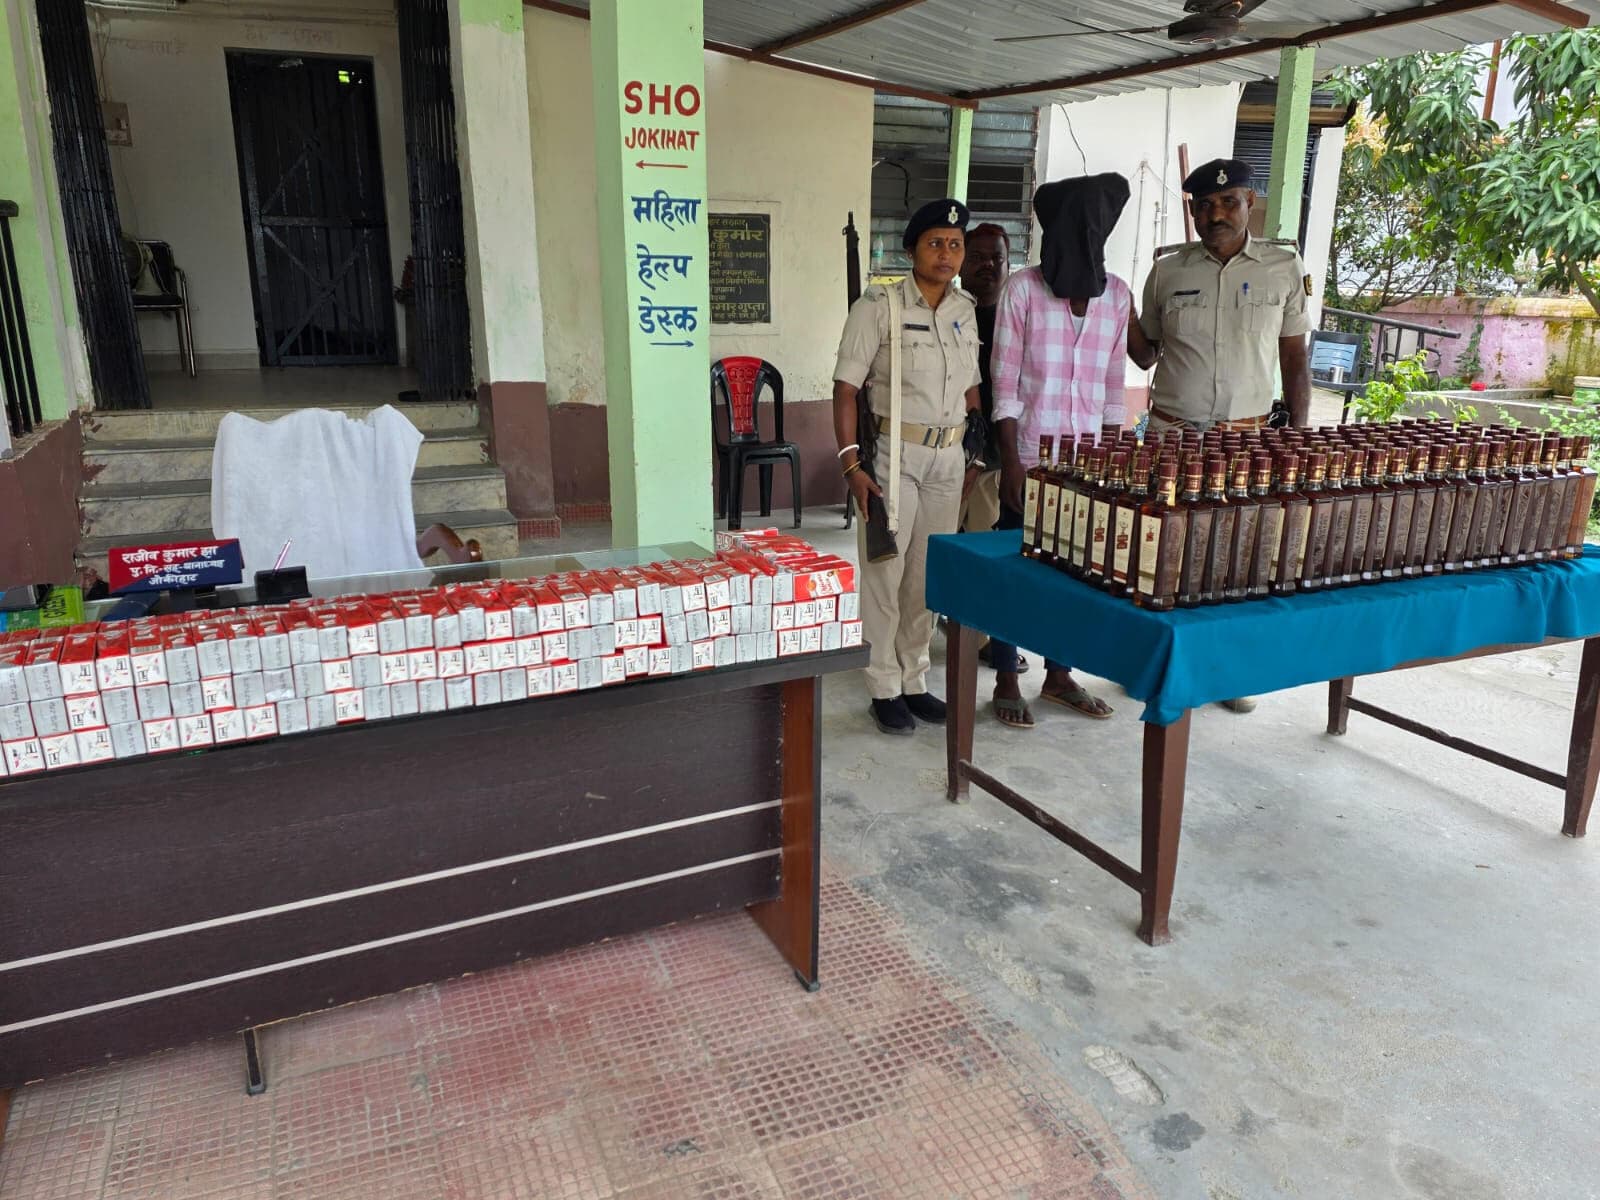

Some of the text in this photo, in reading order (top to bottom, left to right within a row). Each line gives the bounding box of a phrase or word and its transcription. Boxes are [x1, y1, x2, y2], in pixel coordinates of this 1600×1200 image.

[624, 80, 701, 117] SHO
[624, 127, 700, 151] JOKIHAT
[631, 189, 701, 232] महिला
[712, 229, 764, 243] कुमार
[636, 244, 692, 291] हेल्प
[638, 296, 698, 336] डेस्क
[122, 545, 219, 564] राजीव कुमार झा
